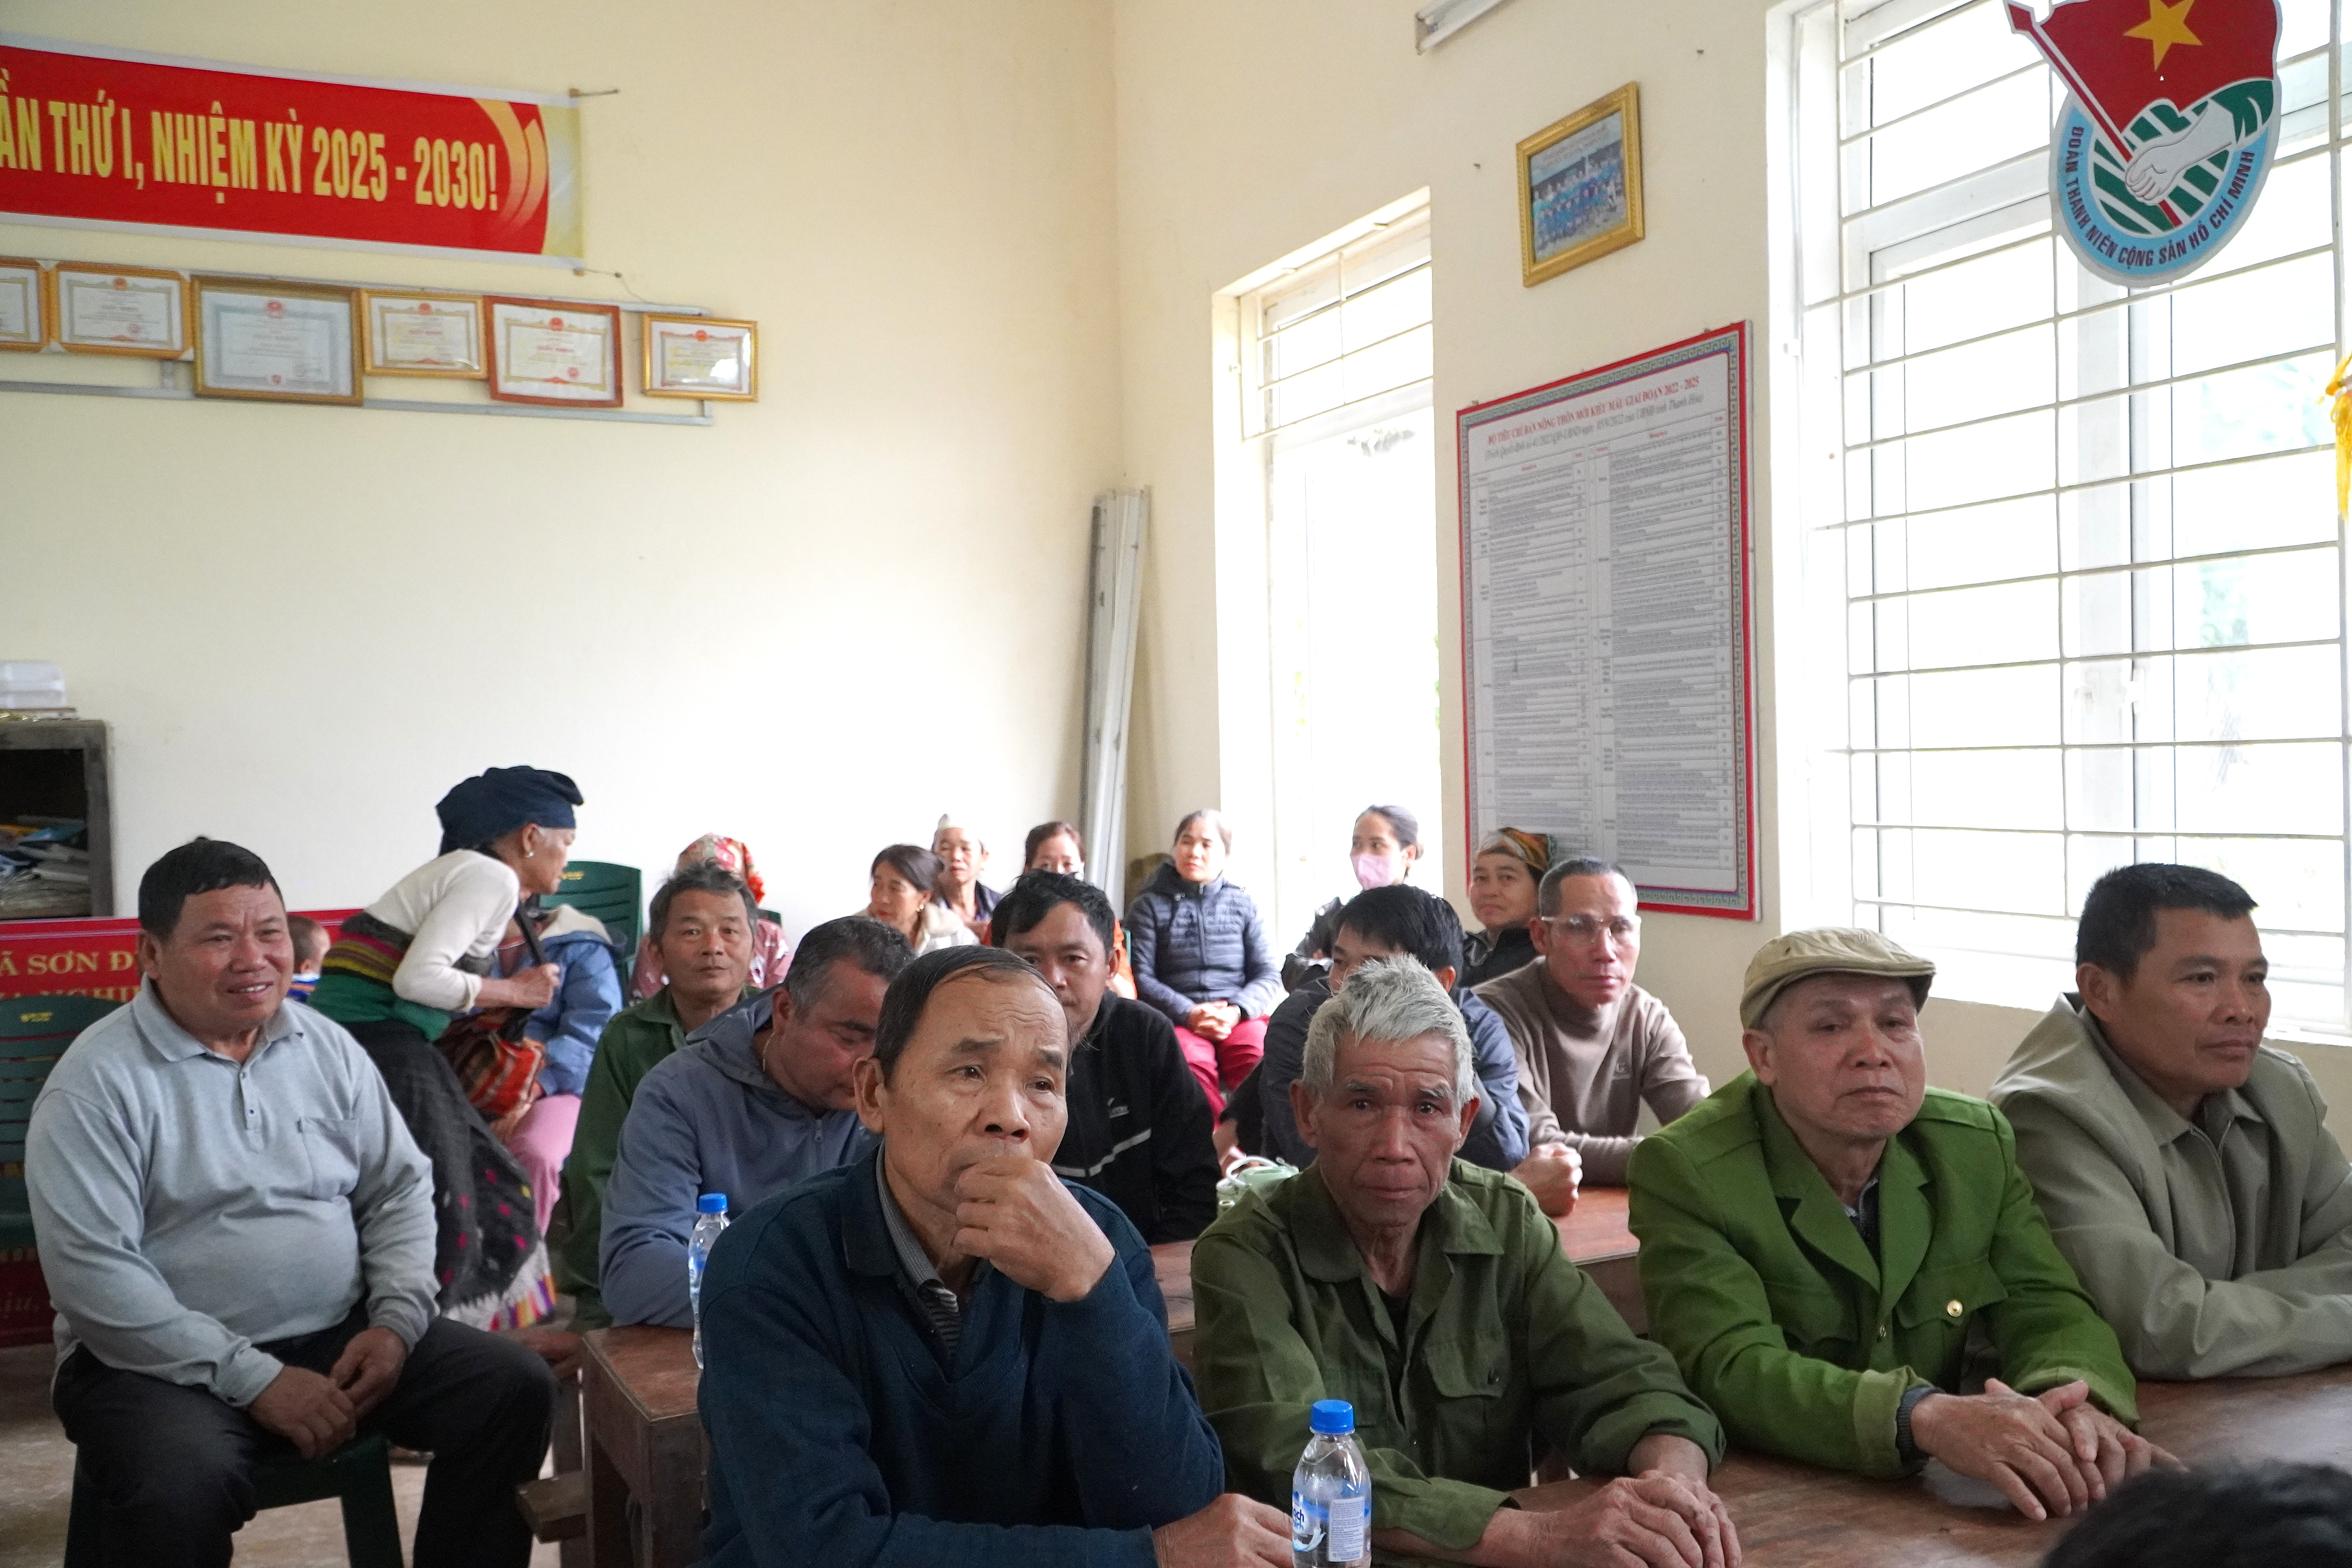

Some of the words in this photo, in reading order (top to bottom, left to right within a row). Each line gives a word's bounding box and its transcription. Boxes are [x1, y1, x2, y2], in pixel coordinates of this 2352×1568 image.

[48, 89, 115, 178] THỨ
[151, 100, 258, 204] NHIỆM
[264, 108, 304, 194] KỲ
[312, 127, 388, 202] 2025
[414, 136, 498, 211] 2030!
[2065, 126, 2085, 172] ĐOÀN
[2227, 151, 2255, 200] MINH
[2066, 177, 2092, 229] THANH
[2209, 196, 2234, 229] CHÍ
[2085, 224, 2119, 258] NIÊN
[2188, 220, 2210, 250] HỒ
[2118, 246, 2154, 270] CỘNG
[2158, 240, 2187, 265] SẢN
[27, 951, 99, 976] SƠN
